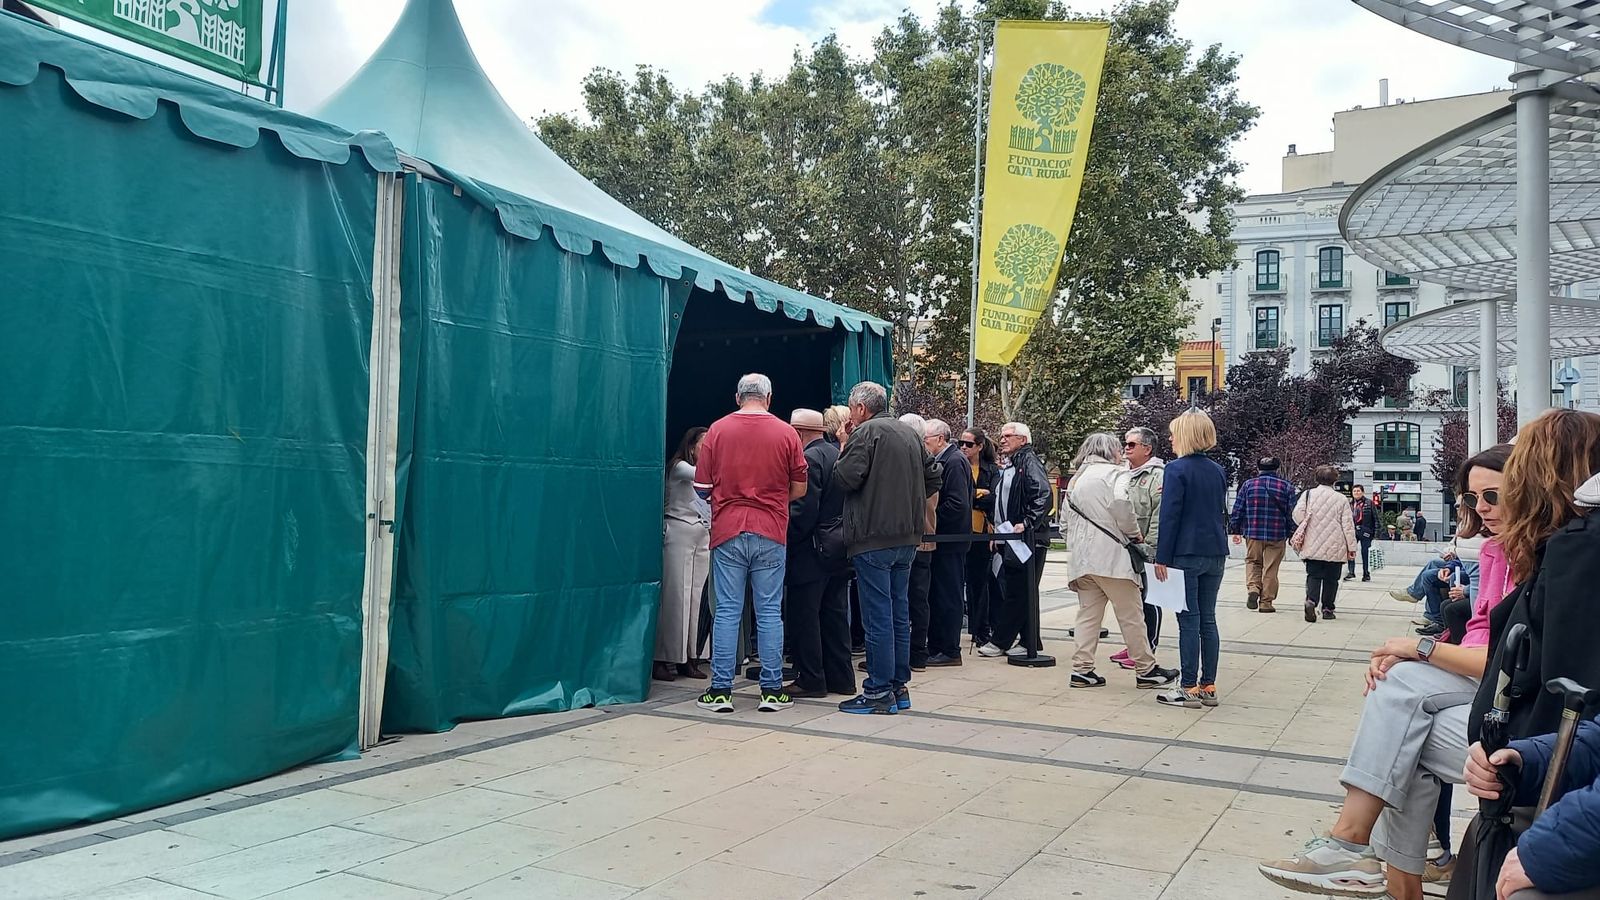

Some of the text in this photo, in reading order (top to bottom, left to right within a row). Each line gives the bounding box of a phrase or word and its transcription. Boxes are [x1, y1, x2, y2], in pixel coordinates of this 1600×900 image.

[1008, 154, 1072, 168] FUNDACION
[1008, 165, 1071, 179] CAJA RURAL
[982, 308, 1038, 326] FUNDACIO
[981, 318, 1032, 334] CAJA RURA
